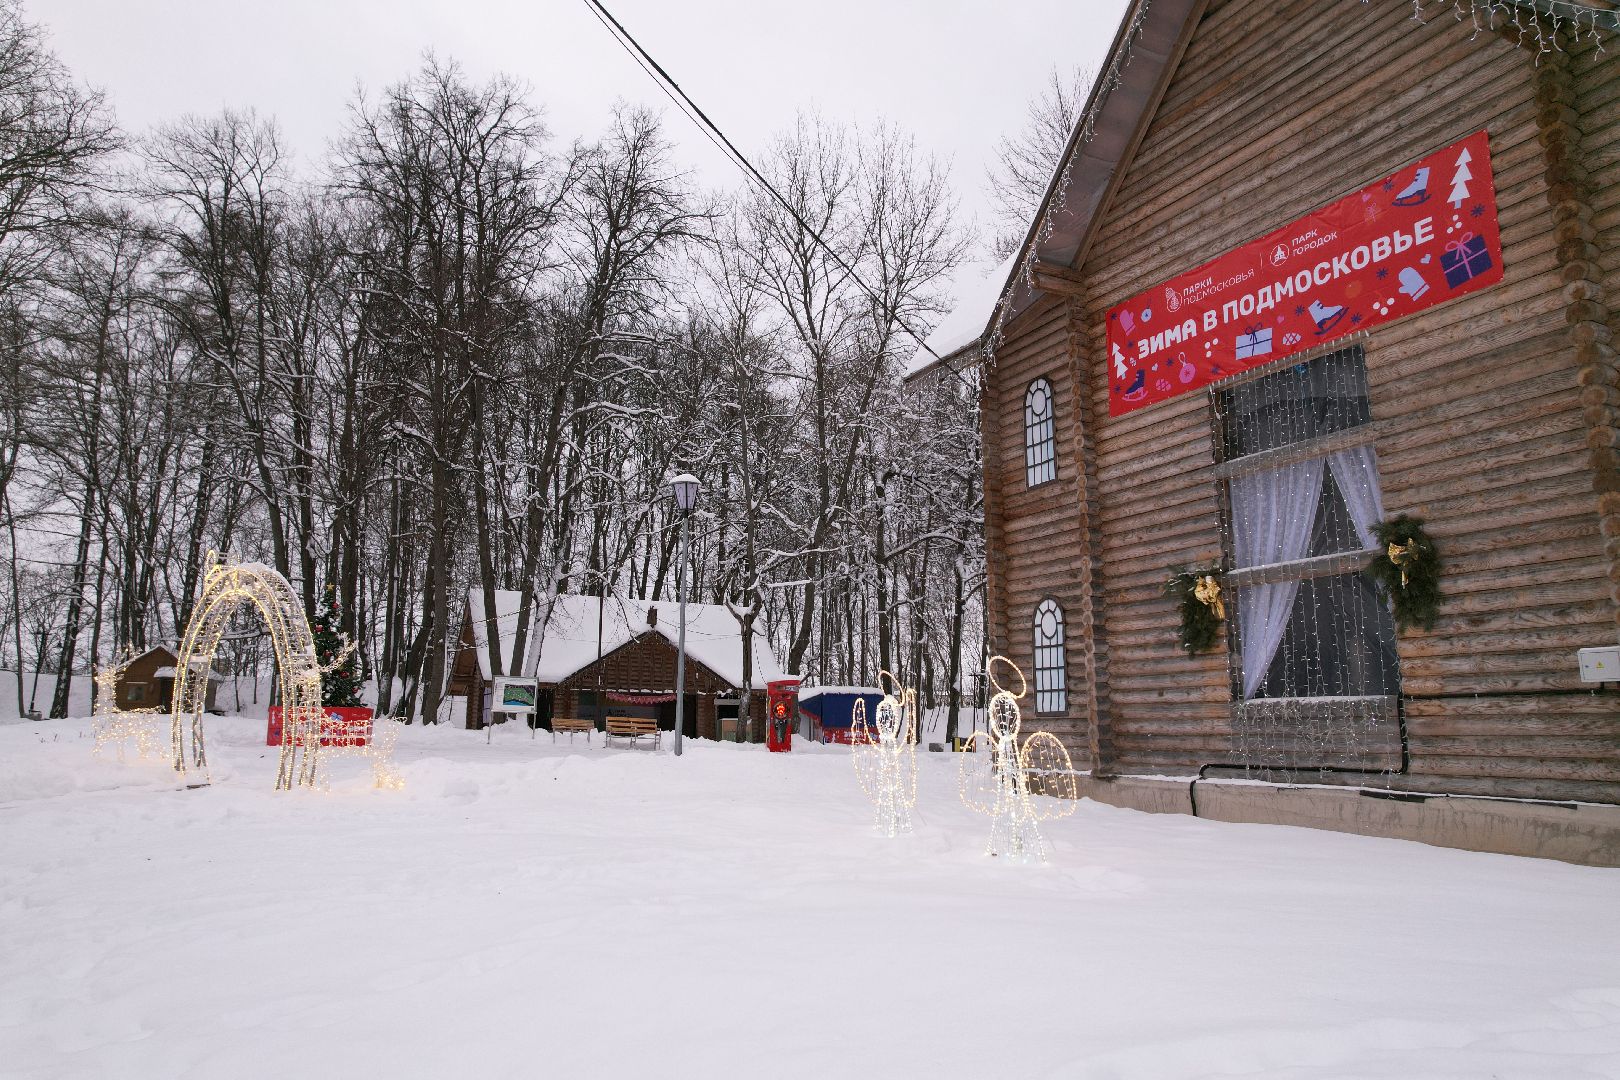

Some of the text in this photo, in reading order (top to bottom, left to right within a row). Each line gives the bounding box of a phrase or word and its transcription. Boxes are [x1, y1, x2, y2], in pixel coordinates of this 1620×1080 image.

[1292, 228, 1318, 246] ПАРК
[1292, 231, 1338, 256] ГОРОДОК
[1137, 216, 1435, 359] ЗИМА В ПОДМОСКОВЬЕ
[1183, 277, 1212, 296] ПАРКИ
[1183, 268, 1255, 305] ПОДМОСКОВЬЯ
